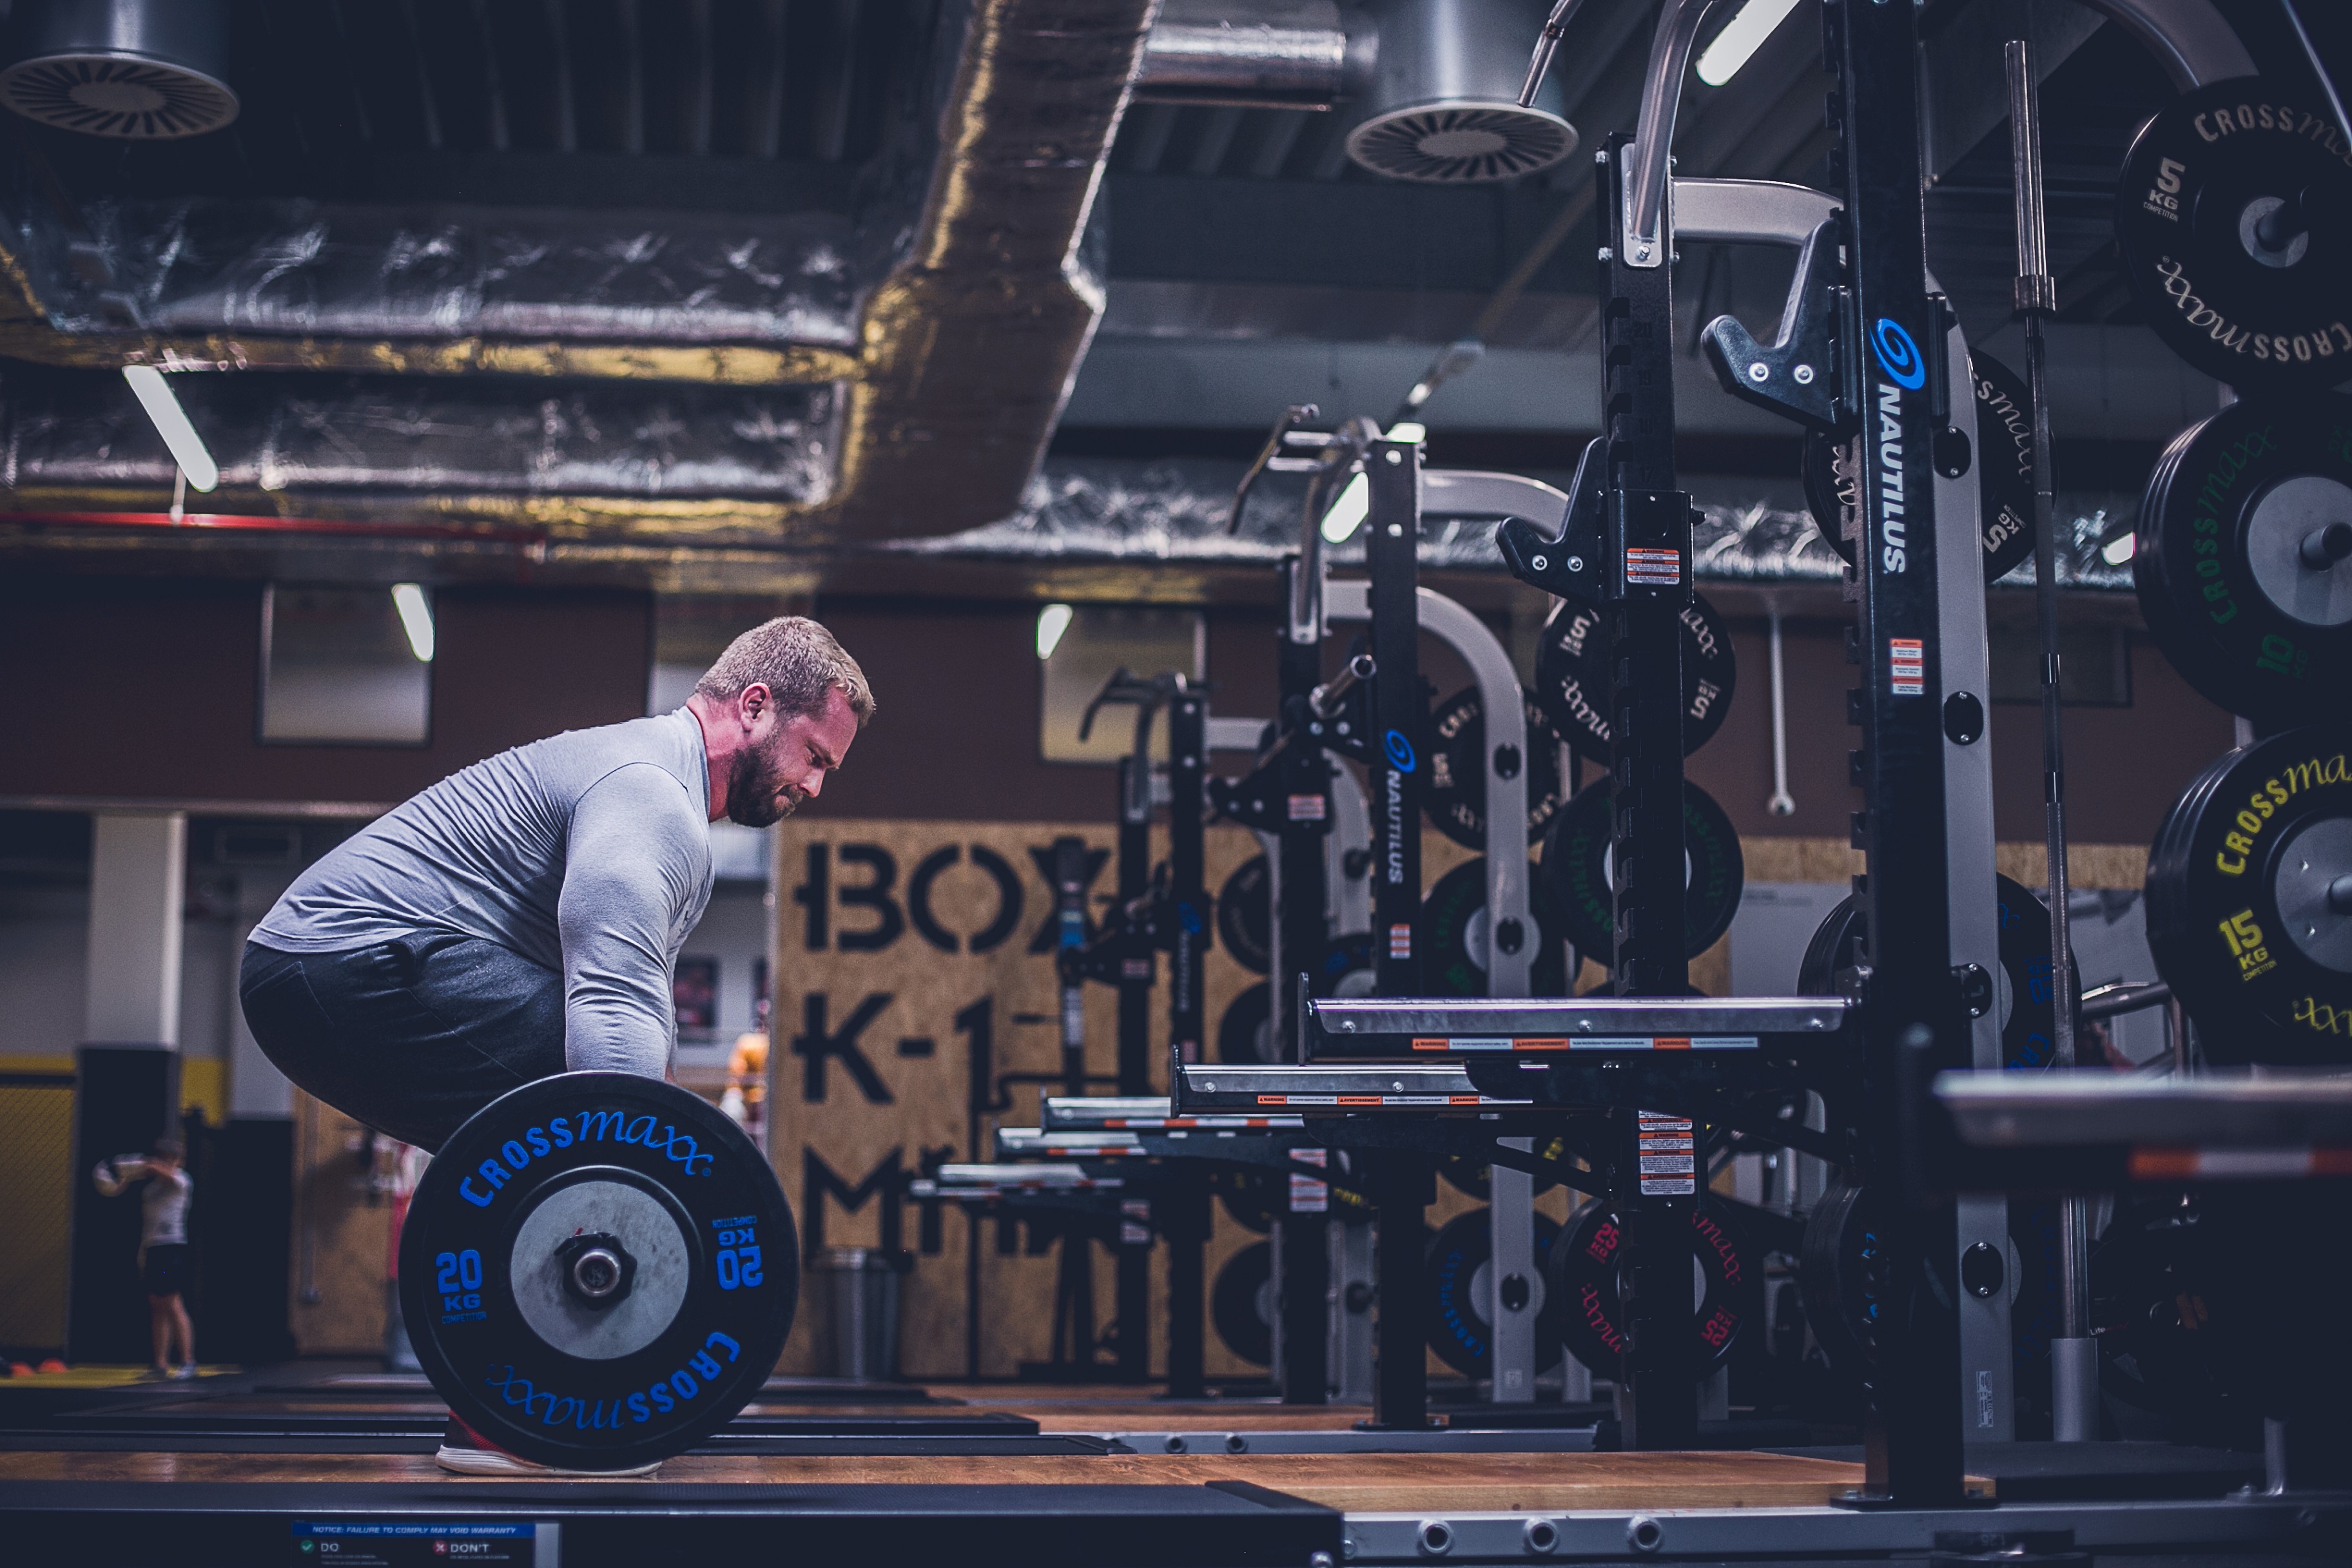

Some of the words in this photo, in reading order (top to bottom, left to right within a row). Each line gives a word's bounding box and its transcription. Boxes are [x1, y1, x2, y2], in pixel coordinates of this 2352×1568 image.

[2157, 157, 2186, 194] 5
[2149, 189, 2179, 210] KG
[2143, 202, 2179, 222] COMPETITION
[1879, 383, 1906, 574] NAUTILUS
[1998, 512, 2019, 534] KG
[1983, 525, 2008, 553] 5
[1570, 616, 1591, 639] 5
[2257, 634, 2294, 675] 10
[1690, 695, 1710, 721] 5
[1387, 769, 1403, 884] NAUTILUS
[2219, 909, 2264, 956] 15
[2238, 947, 2269, 970] KG
[2242, 960, 2277, 982] COMPETITION
[712, 1215, 757, 1229] COMPETITION
[717, 1228, 755, 1246] KG
[1595, 1223, 1619, 1250] 25
[436, 1250, 482, 1293] 20
[715, 1246, 763, 1290] 20
[444, 1293, 481, 1312] KG
[442, 1311, 487, 1324] COMPETITION
[1700, 1319, 1729, 1347] 25
[320, 1543, 339, 1552] DO
[450, 1544, 490, 1553] DON'T
